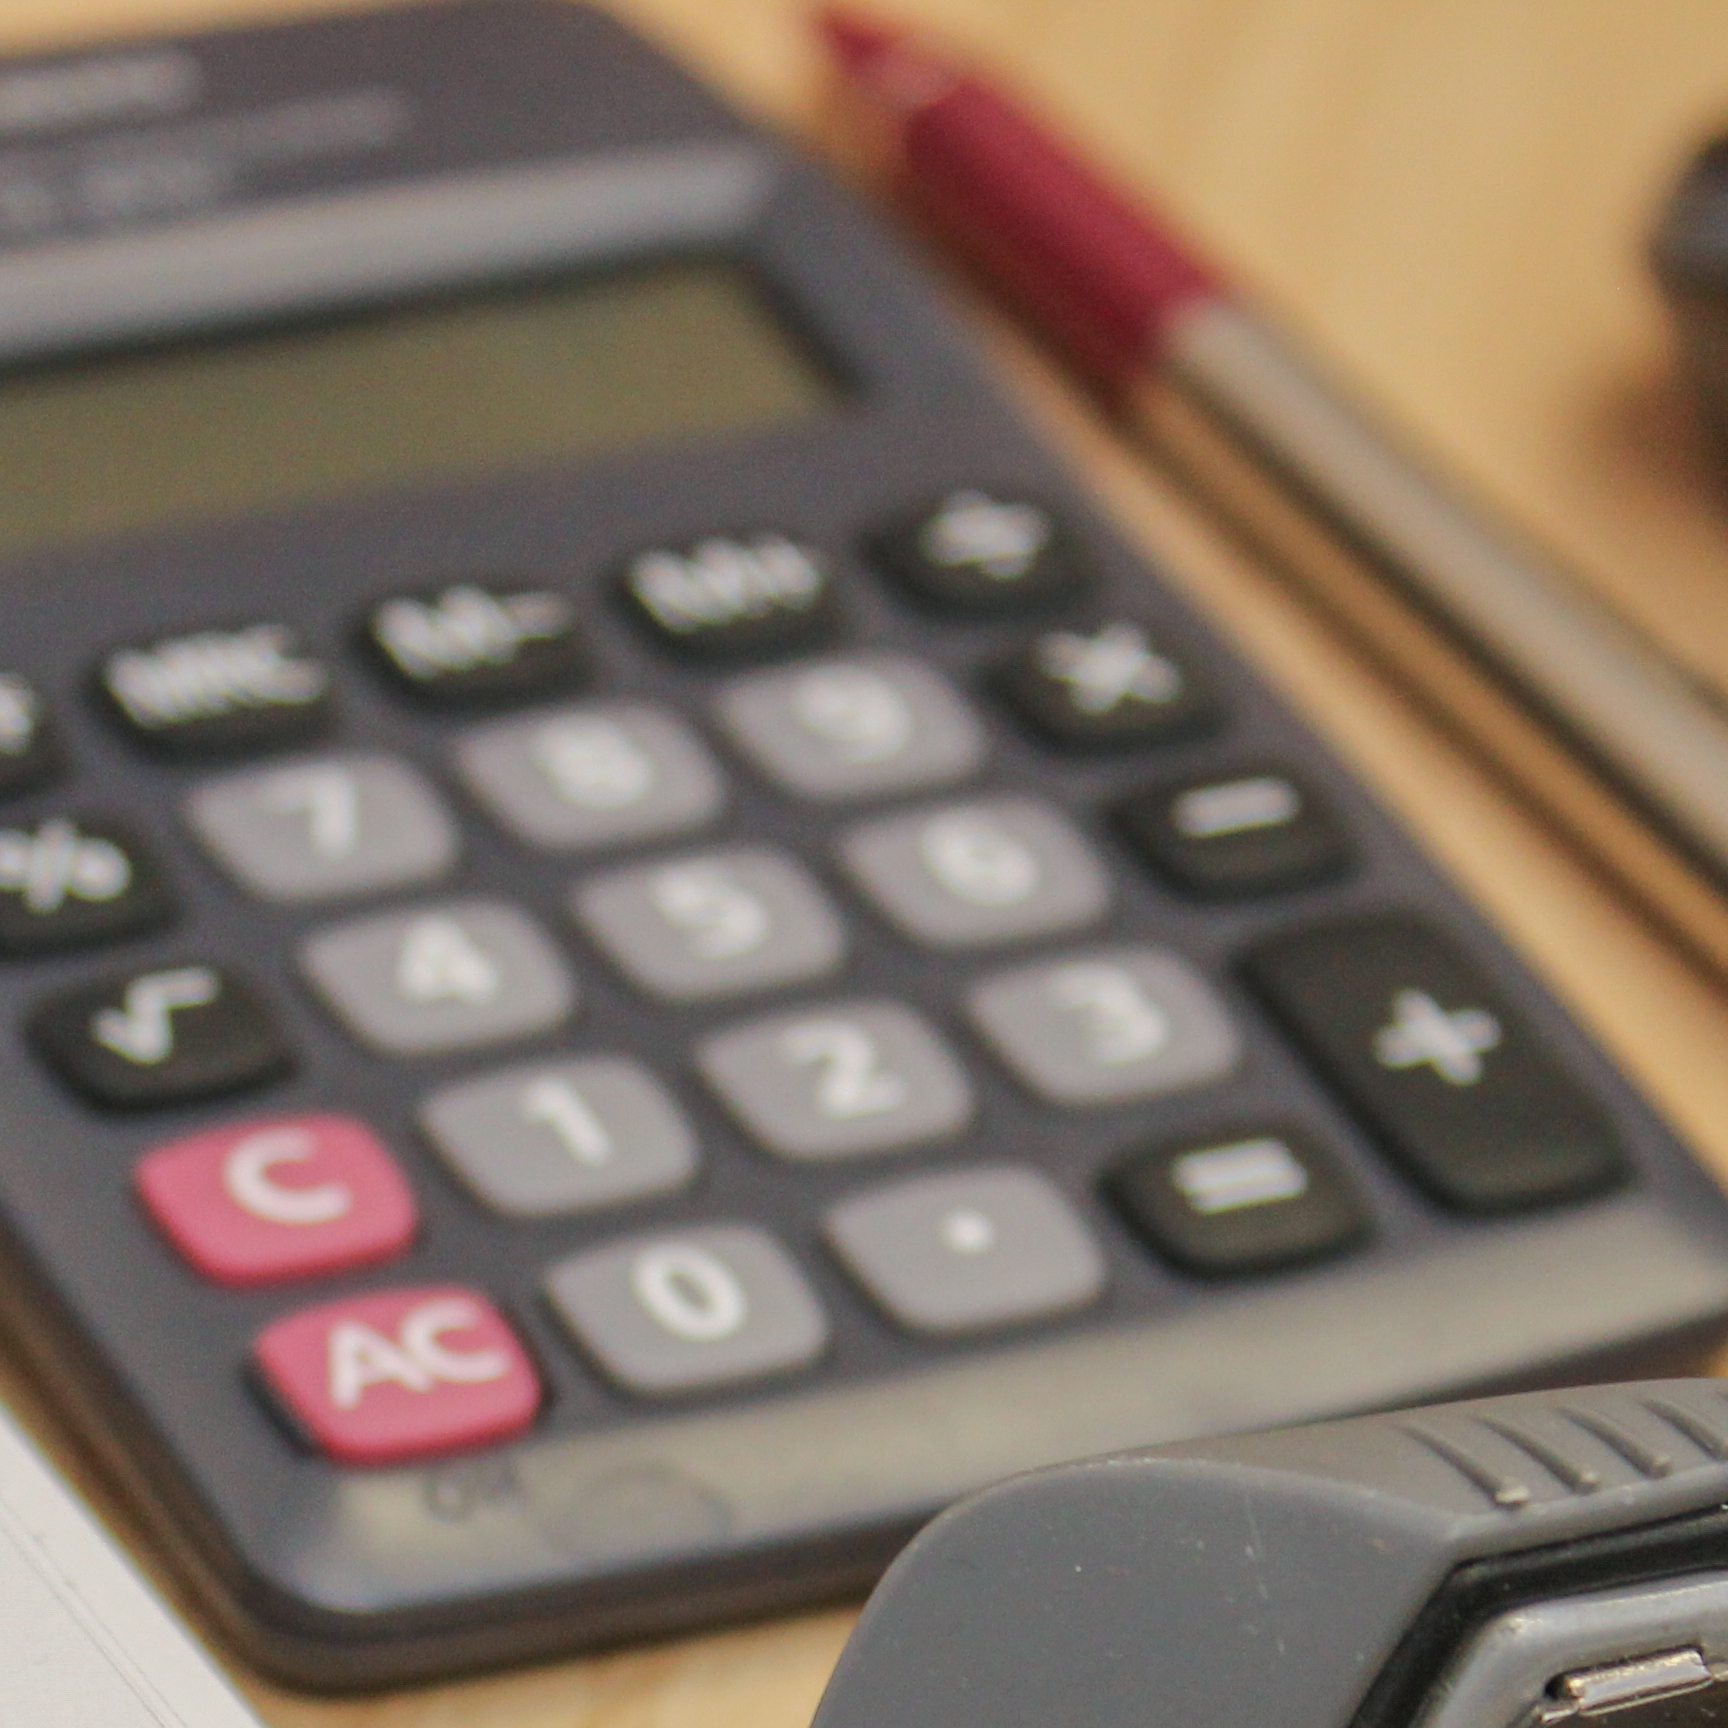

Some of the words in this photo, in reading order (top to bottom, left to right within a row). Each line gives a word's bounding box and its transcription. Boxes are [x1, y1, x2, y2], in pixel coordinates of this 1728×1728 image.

[528, 706, 656, 810] 8
[788, 657, 917, 766] 9
[260, 766, 359, 860] 7
[917, 816, 1042, 908] 6
[395, 914, 502, 1002] 4
[648, 866, 772, 962] 5
[1062, 960, 1170, 1068] 3
[780, 1016, 906, 1122] 2
[518, 1074, 614, 1168] 1
[220, 1126, 354, 1226] C
[630, 1240, 749, 1344] 0
[325, 1295, 512, 1412] AC
